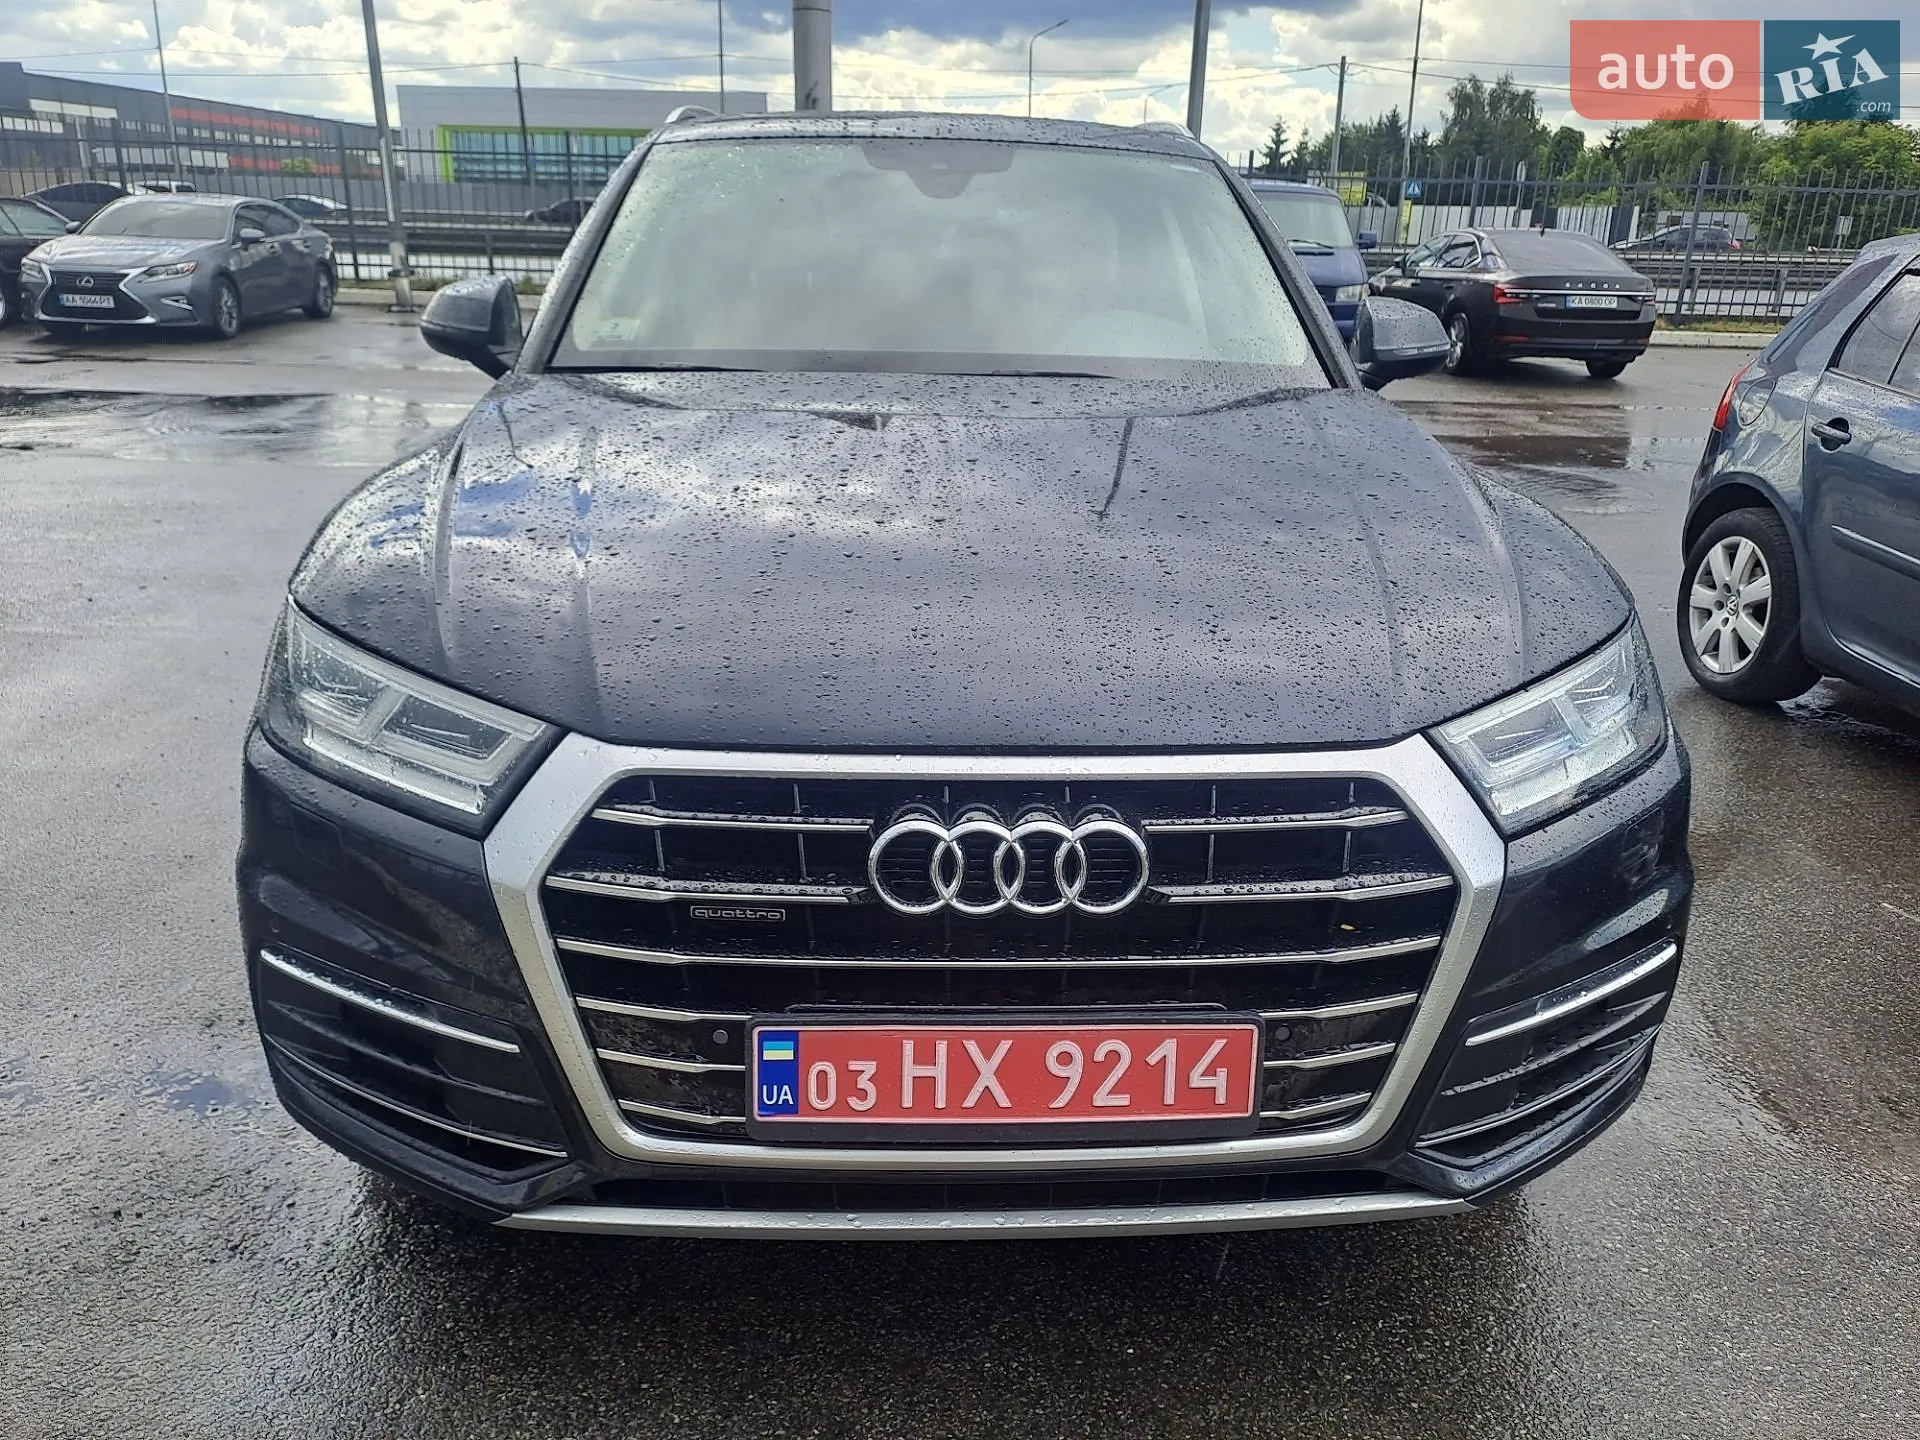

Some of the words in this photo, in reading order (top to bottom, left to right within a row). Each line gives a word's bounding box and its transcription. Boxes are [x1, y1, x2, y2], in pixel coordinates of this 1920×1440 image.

[694, 908, 780, 919] quattro
[762, 1084, 794, 1105] UA
[807, 1060, 877, 1112] 03
[900, 1039, 1013, 1109] HX
[1045, 1038, 1228, 1109] 9214
